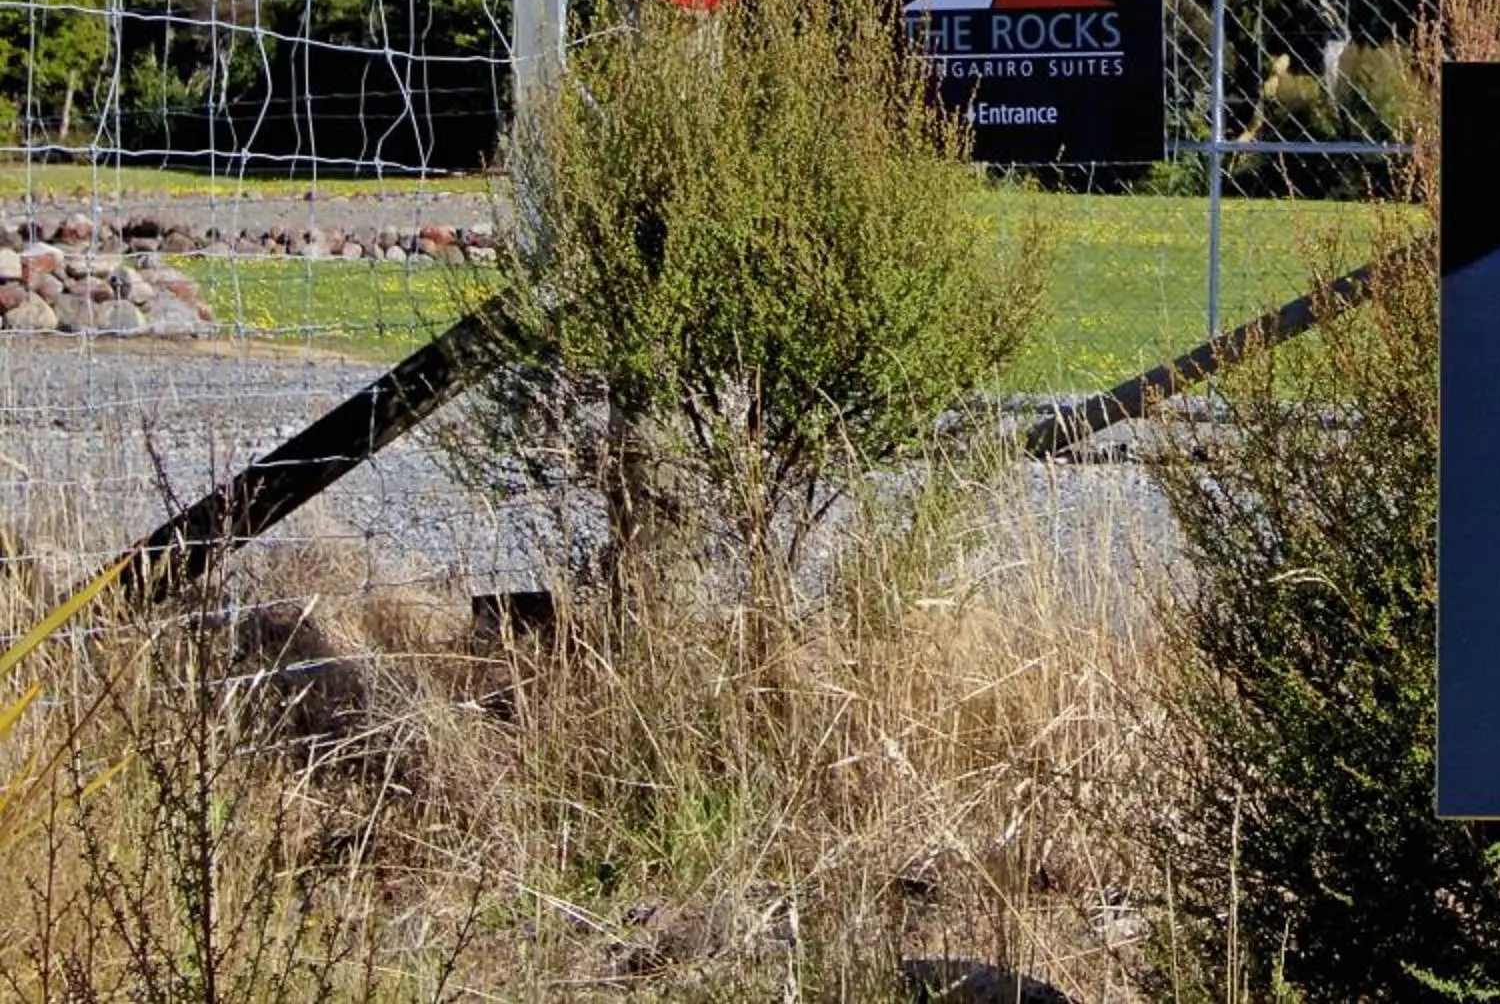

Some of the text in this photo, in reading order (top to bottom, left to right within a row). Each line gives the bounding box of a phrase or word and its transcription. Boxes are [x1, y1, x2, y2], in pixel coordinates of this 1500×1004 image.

[991, 12, 1121, 50] ROCKS
[1050, 58, 1124, 77] SUITES
[978, 102, 1059, 125] Entrance
